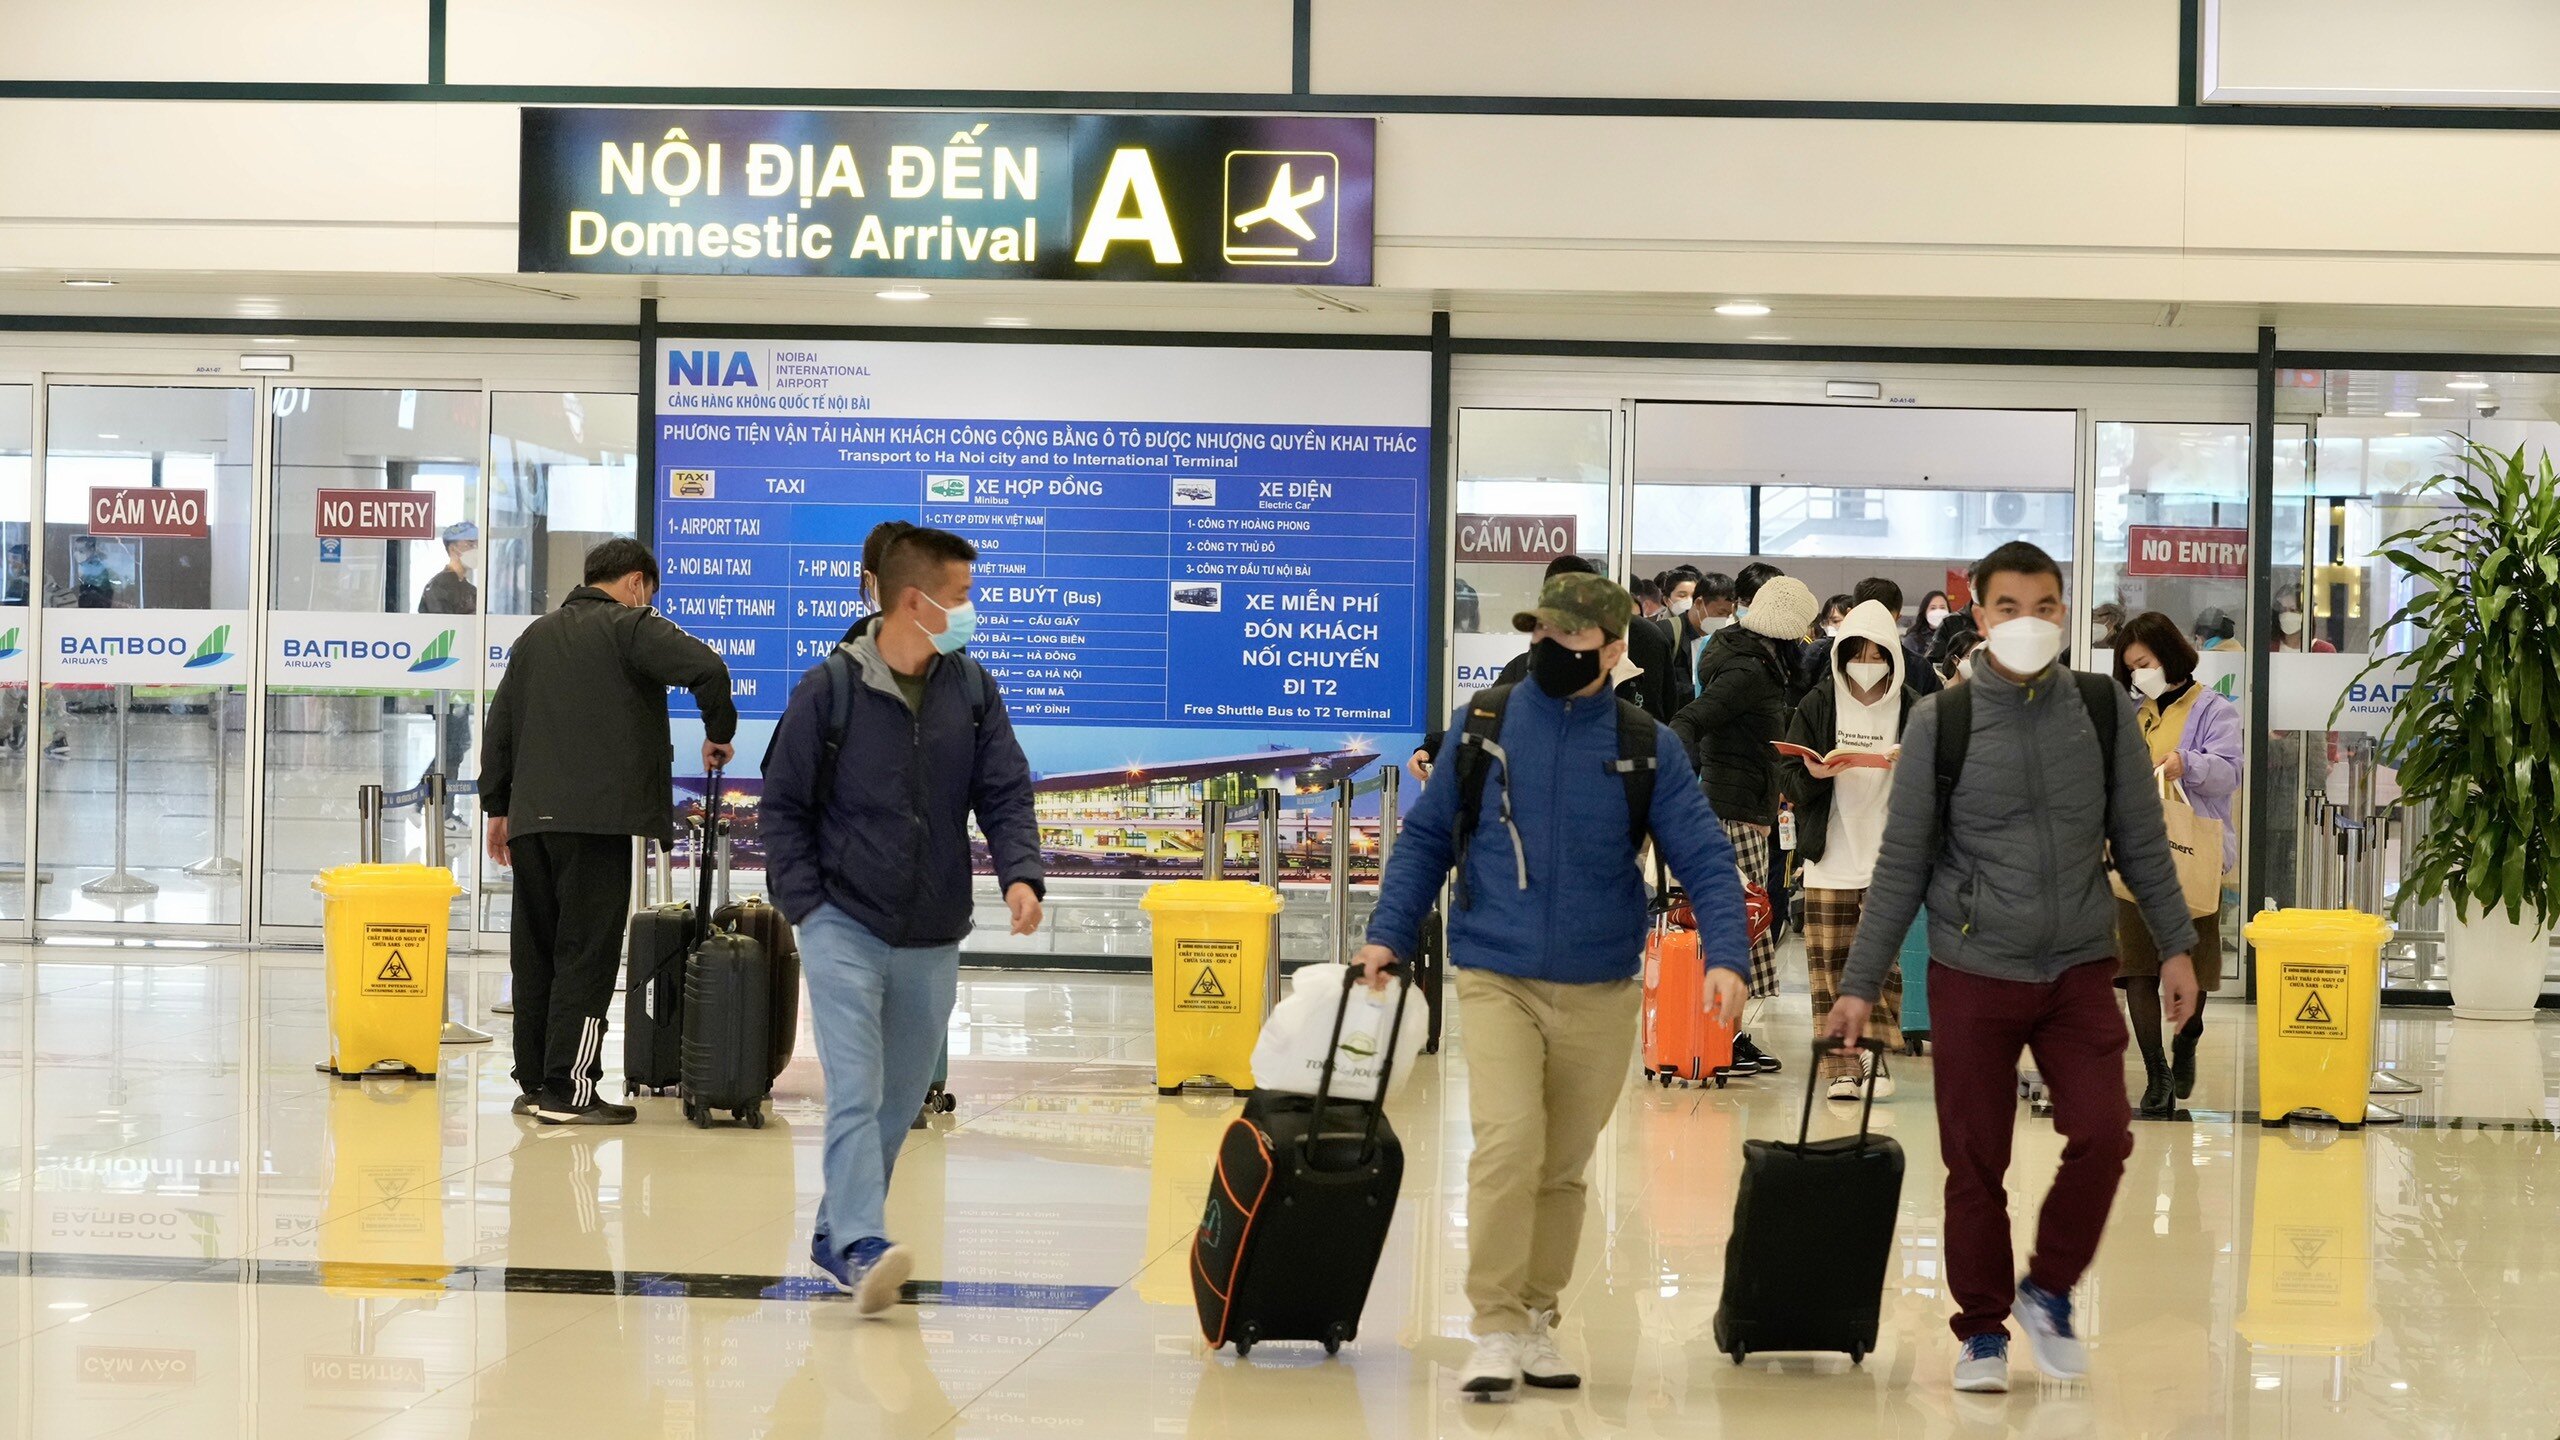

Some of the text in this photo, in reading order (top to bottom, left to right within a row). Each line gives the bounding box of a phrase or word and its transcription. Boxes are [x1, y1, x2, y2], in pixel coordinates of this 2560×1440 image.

[601, 124, 1038, 208] NỘI ĐỊA ĐẾN
[1075, 148, 1182, 264] A
[570, 210, 1036, 262] Domestic Arrival
[776, 352, 817, 362] NOIBAI
[669, 351, 758, 386] NIA
[776, 365, 870, 375] INTERNATIONAL
[776, 379, 828, 388] AIRPORT
[669, 392, 870, 412] CẢNG HÀNG KHÔNG QUỐC TẾ NỘI BÀI
[664, 422, 1416, 453] PHƯƠNG TIỆN VẬN TẢI HÀNH KHÁCH CÔNG CỘNG BẰNG Ô TÔ ĐƯỢC NHƯỢNG QUYỀN KHAI THÁC
[838, 449, 1238, 468] Transport to Ha Noi city and to International Terminal
[766, 478, 804, 494] TAXI
[976, 475, 1102, 498] XE HỢP ĐỒNG
[1260, 480, 1332, 501] XE ĐIỆN
[96, 490, 196, 526] CẤM VÀO
[974, 496, 1008, 504] Minibus
[1260, 501, 1310, 510] Electric Car
[324, 502, 429, 528] NO ENTRY
[1198, 517, 1310, 530] CÔNG TY HOÀNG PHONG
[668, 518, 760, 535] 1- AIRPORT TAXI
[1461, 517, 1567, 552] CẤM VÀO
[982, 540, 999, 548] SAO
[1198, 540, 1276, 552] CÔNG TY THỦ ĐÔ
[2142, 540, 2246, 564] NO ENTRY
[668, 558, 750, 576] 2- NOI BAI TAXI
[799, 560, 808, 576] 7-
[812, 560, 827, 576] HP
[830, 560, 850, 577] NOI
[978, 562, 996, 576] VIỆT
[998, 564, 1026, 574] THANH
[1196, 562, 1310, 577] CÔNG TY ĐẦU TƯ NỘI BÀI
[980, 585, 1101, 606] XE BUÝT (Bus)
[1246, 589, 1380, 612] XE MIỄN PHÍ
[666, 595, 774, 619] 3- TAXI VIỆT THANH
[798, 600, 808, 616] 8-
[811, 600, 836, 617] TAXI
[991, 614, 1080, 626] BÀI CẦU GIẤY
[971, 632, 1085, 644] NỘI BÀI LONG BIÊN
[1244, 619, 1378, 640] ĐÓN KHÁCH
[61, 637, 186, 656] BAMBOO
[284, 640, 410, 659] BAMBOO
[730, 639, 755, 655] NAM
[970, 650, 1076, 660] NỘI BÀI HÀ ĐÔNG
[284, 660, 331, 668] AIRWAYS
[1243, 644, 1379, 668] NỐI CHUYẾN
[992, 667, 1082, 680] BÀI GA HÀ NỘI
[1026, 686, 1064, 696] KIM MÃ
[1284, 679, 1336, 696] ĐI T2
[1026, 704, 1070, 714] MỸ ĐÌNH
[1184, 704, 1390, 718] Free Shuttle Bus to T2 Terminal
